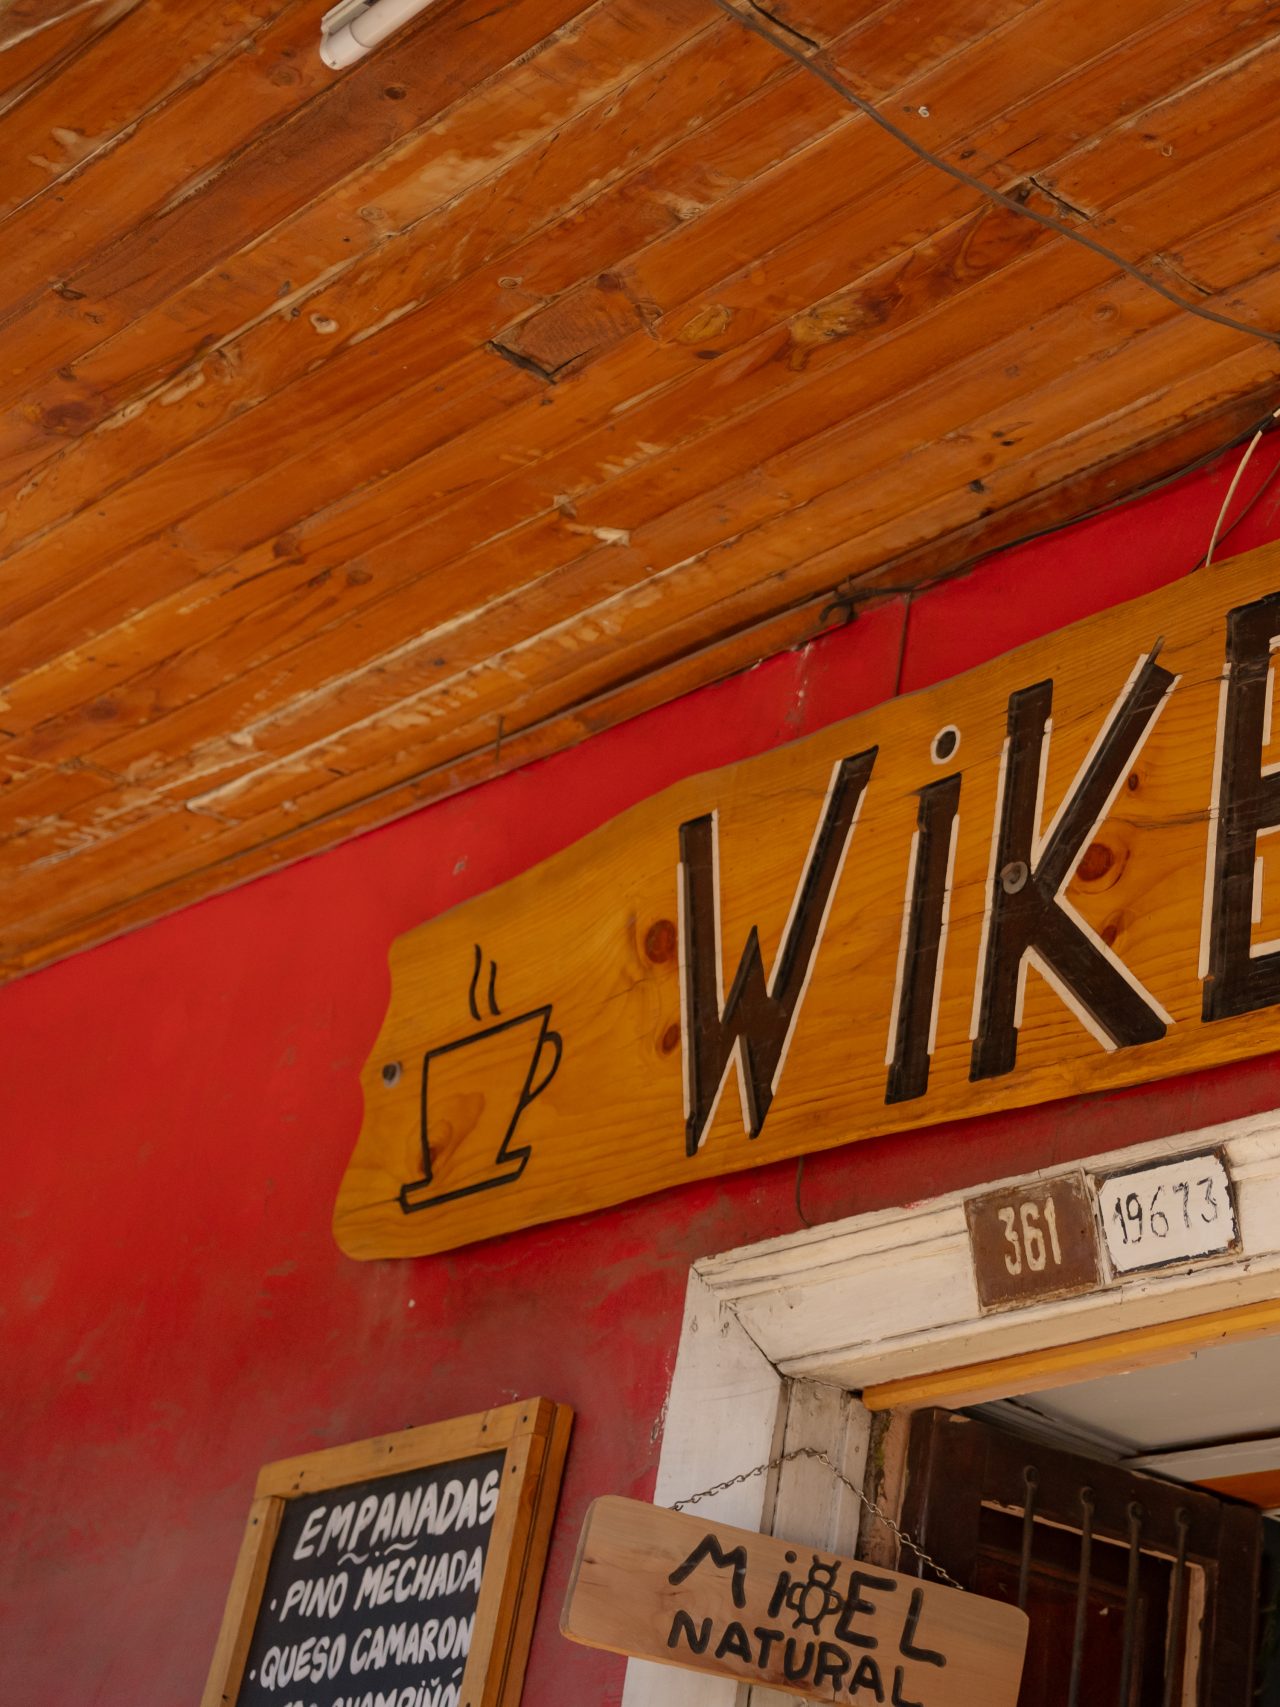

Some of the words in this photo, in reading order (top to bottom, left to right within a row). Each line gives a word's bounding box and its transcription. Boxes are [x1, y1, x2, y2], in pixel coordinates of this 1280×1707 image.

[998, 1197, 1062, 1276] 361
[1112, 1176, 1218, 1245] 19673
[293, 1469, 500, 1561] EMPANADAS
[278, 1570, 348, 1623] PINO
[353, 1545, 484, 1611] MECHADA
[259, 1632, 347, 1692] QUESO
[667, 1608, 924, 1707] NATURAL
